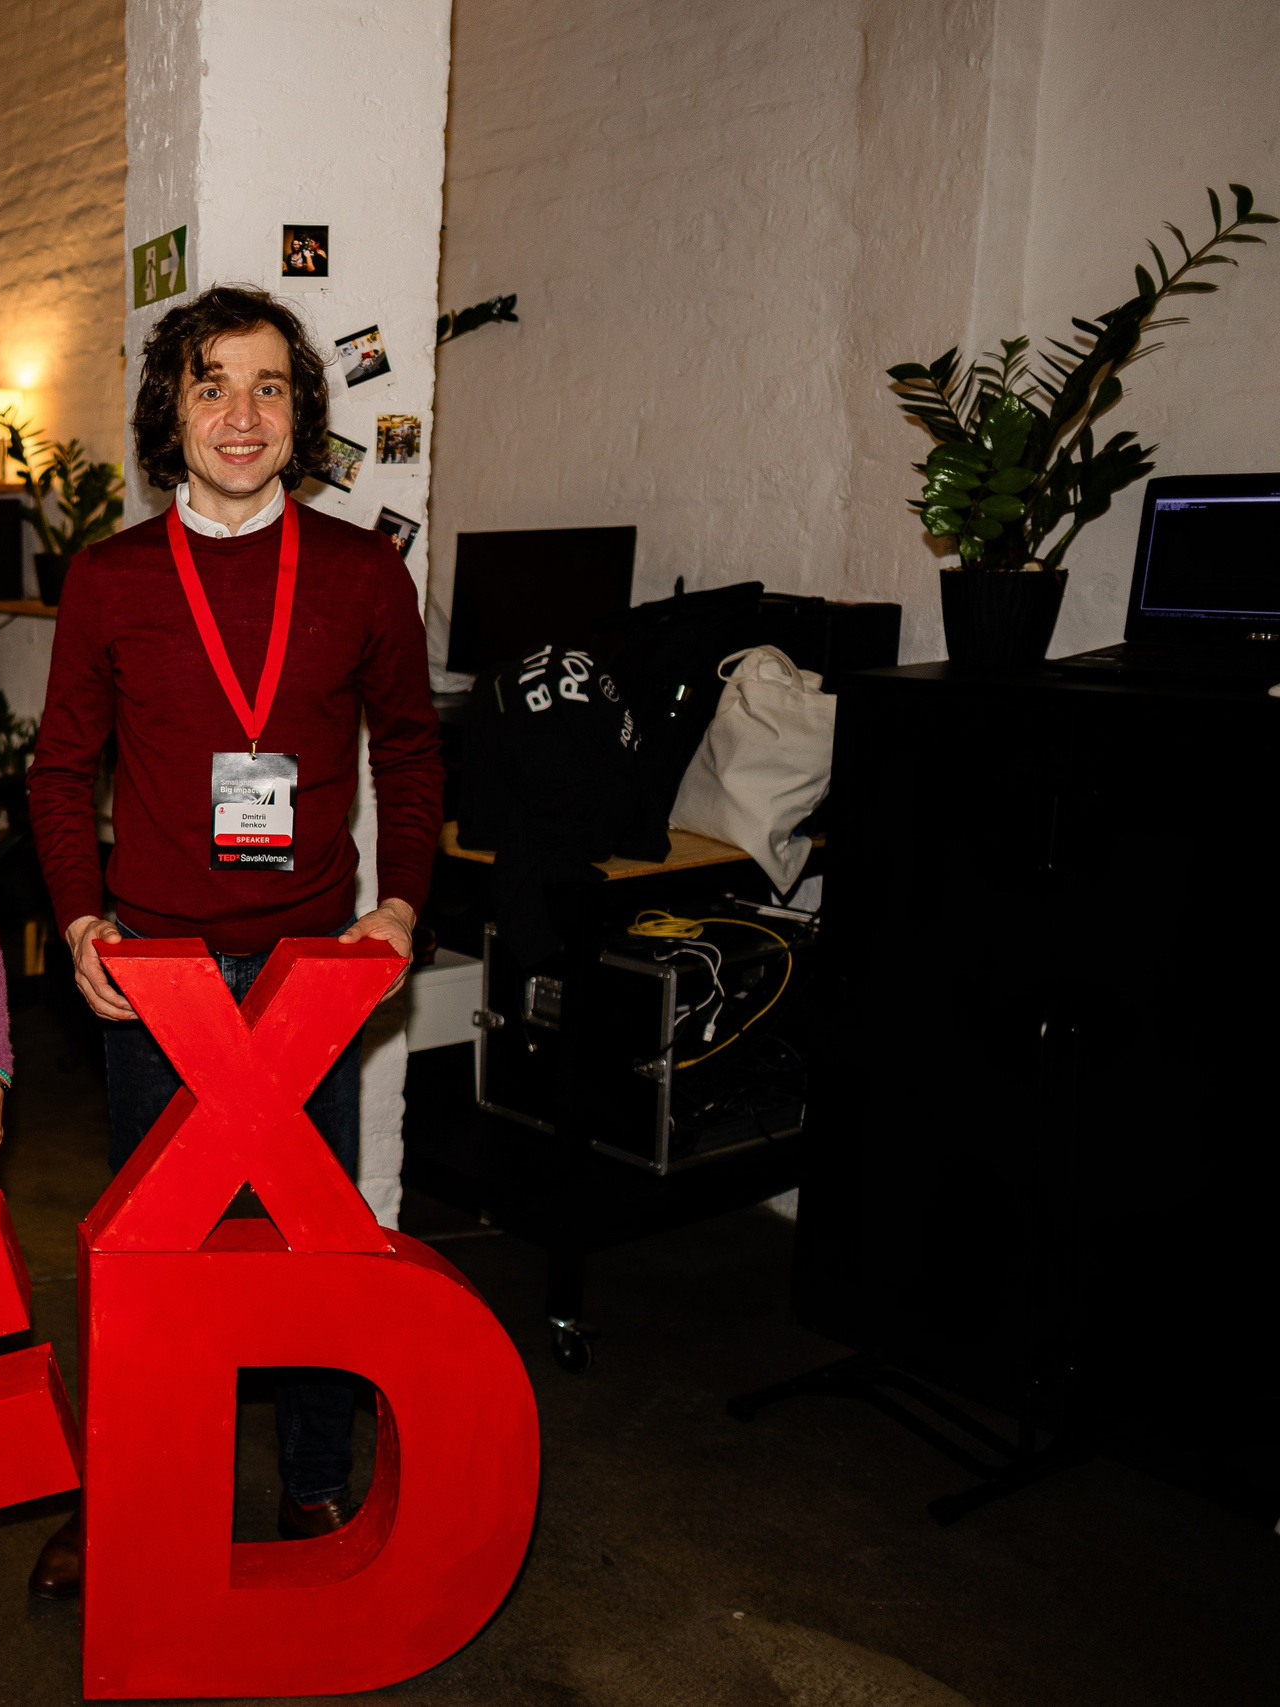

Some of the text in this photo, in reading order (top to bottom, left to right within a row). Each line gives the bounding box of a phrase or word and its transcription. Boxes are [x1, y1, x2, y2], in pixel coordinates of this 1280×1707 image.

[220, 785, 233, 795] Big
[242, 813, 267, 821] Dmitrii
[236, 836, 270, 844] SPEAKER
